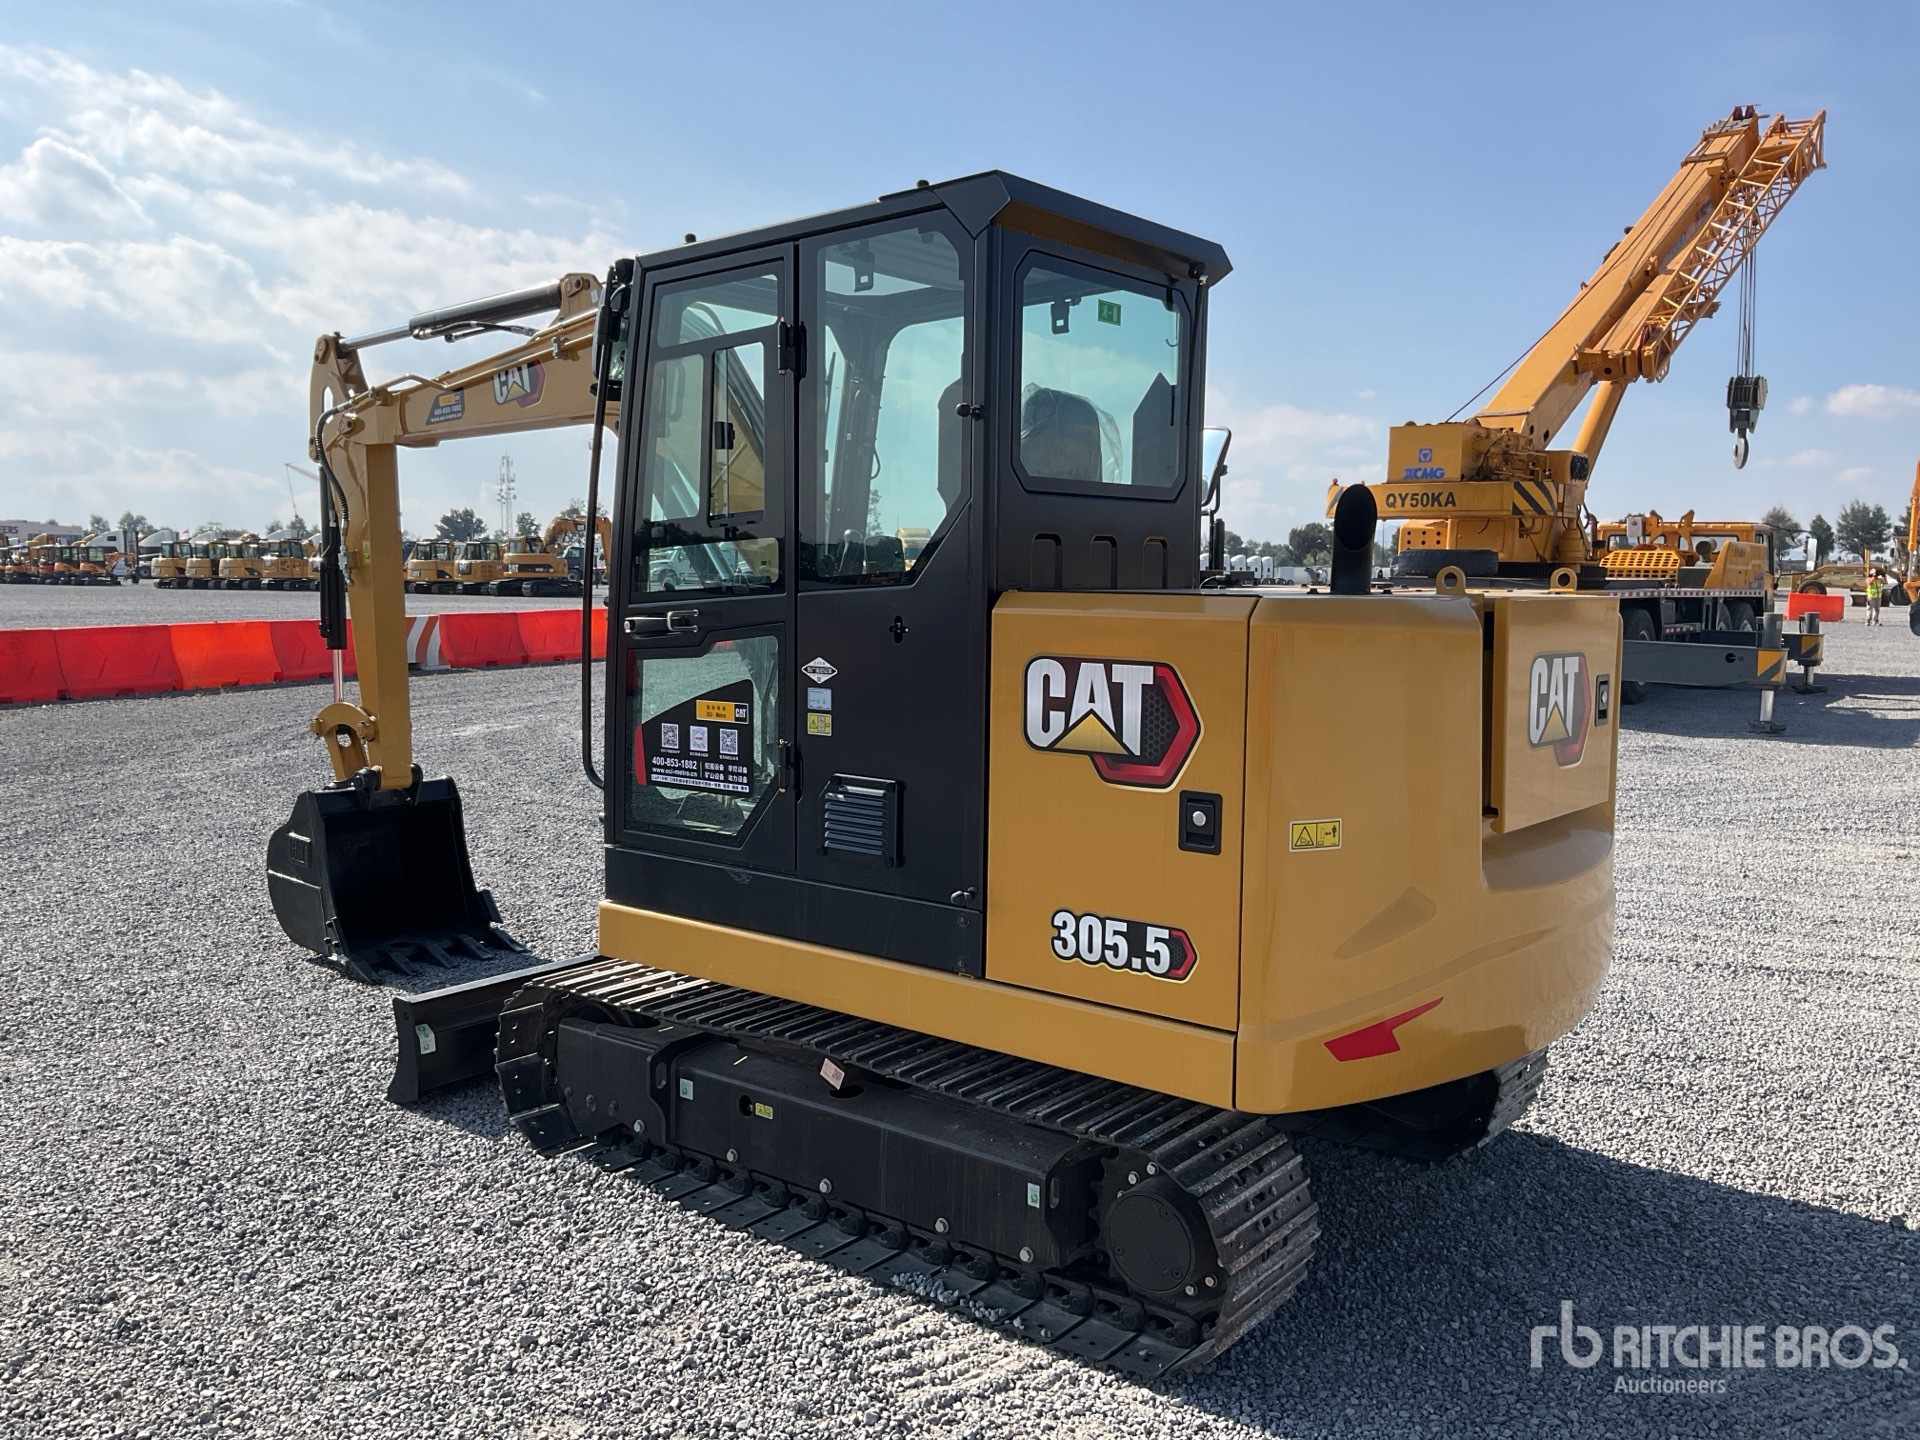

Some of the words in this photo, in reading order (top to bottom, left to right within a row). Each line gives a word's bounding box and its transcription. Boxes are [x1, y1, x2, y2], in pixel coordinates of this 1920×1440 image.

[493, 363, 531, 405] CAT
[1404, 467, 1446, 480] XCMG
[1386, 491, 1456, 509] QY50KA
[508, 564, 519, 573] CAT
[1027, 658, 1154, 757] CAT
[1530, 656, 1580, 745] CAT
[735, 708, 747, 718] CAT
[652, 756, 697, 770] 400-853-1882
[1052, 911, 1171, 975] 305.5
